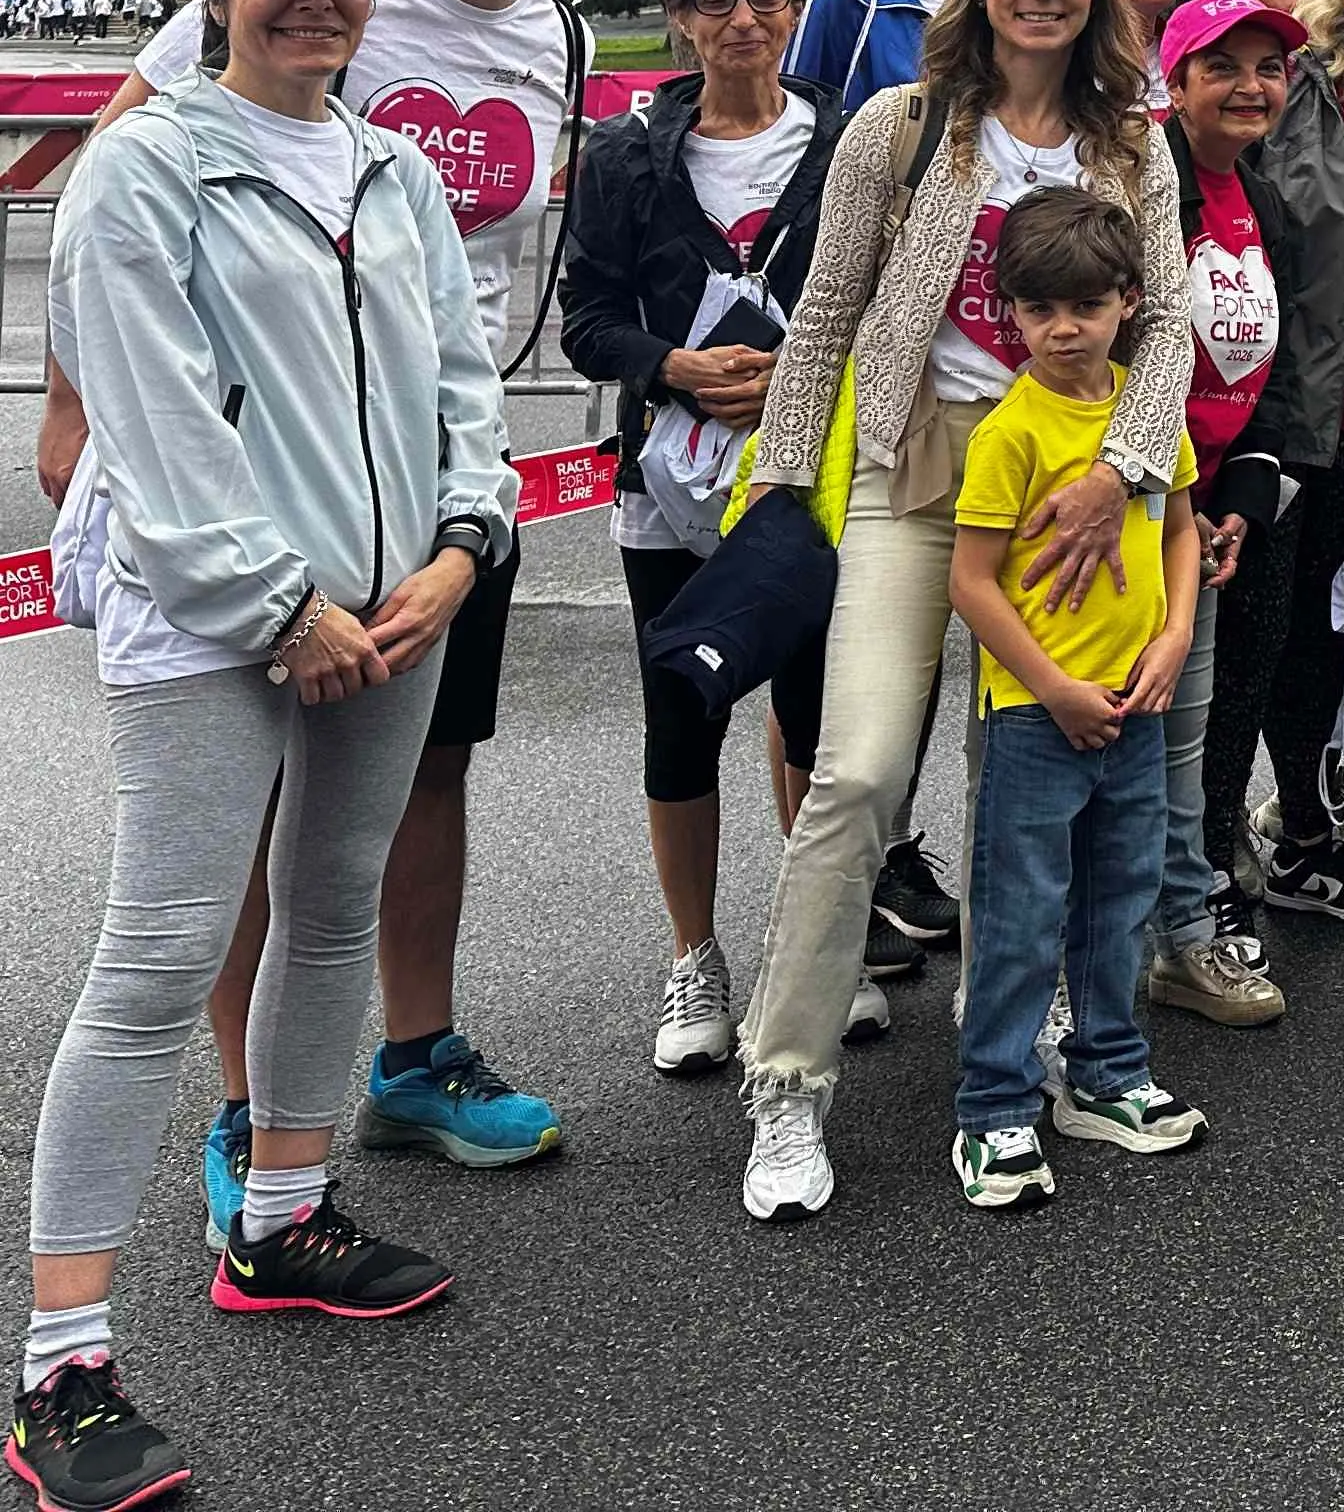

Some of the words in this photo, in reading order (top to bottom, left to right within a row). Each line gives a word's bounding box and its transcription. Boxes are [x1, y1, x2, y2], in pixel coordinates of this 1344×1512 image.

[464, 160, 517, 188] THE
[961, 268, 998, 292] FO
[1209, 319, 1264, 343] CURE
[1225, 348, 1254, 363] 2026
[555, 457, 593, 476] RACE
[558, 473, 585, 490] FOR
[587, 467, 610, 484] THE
[558, 484, 594, 504] CURE
[36, 580, 55, 598] TH
[0, 597, 48, 623] CURE
